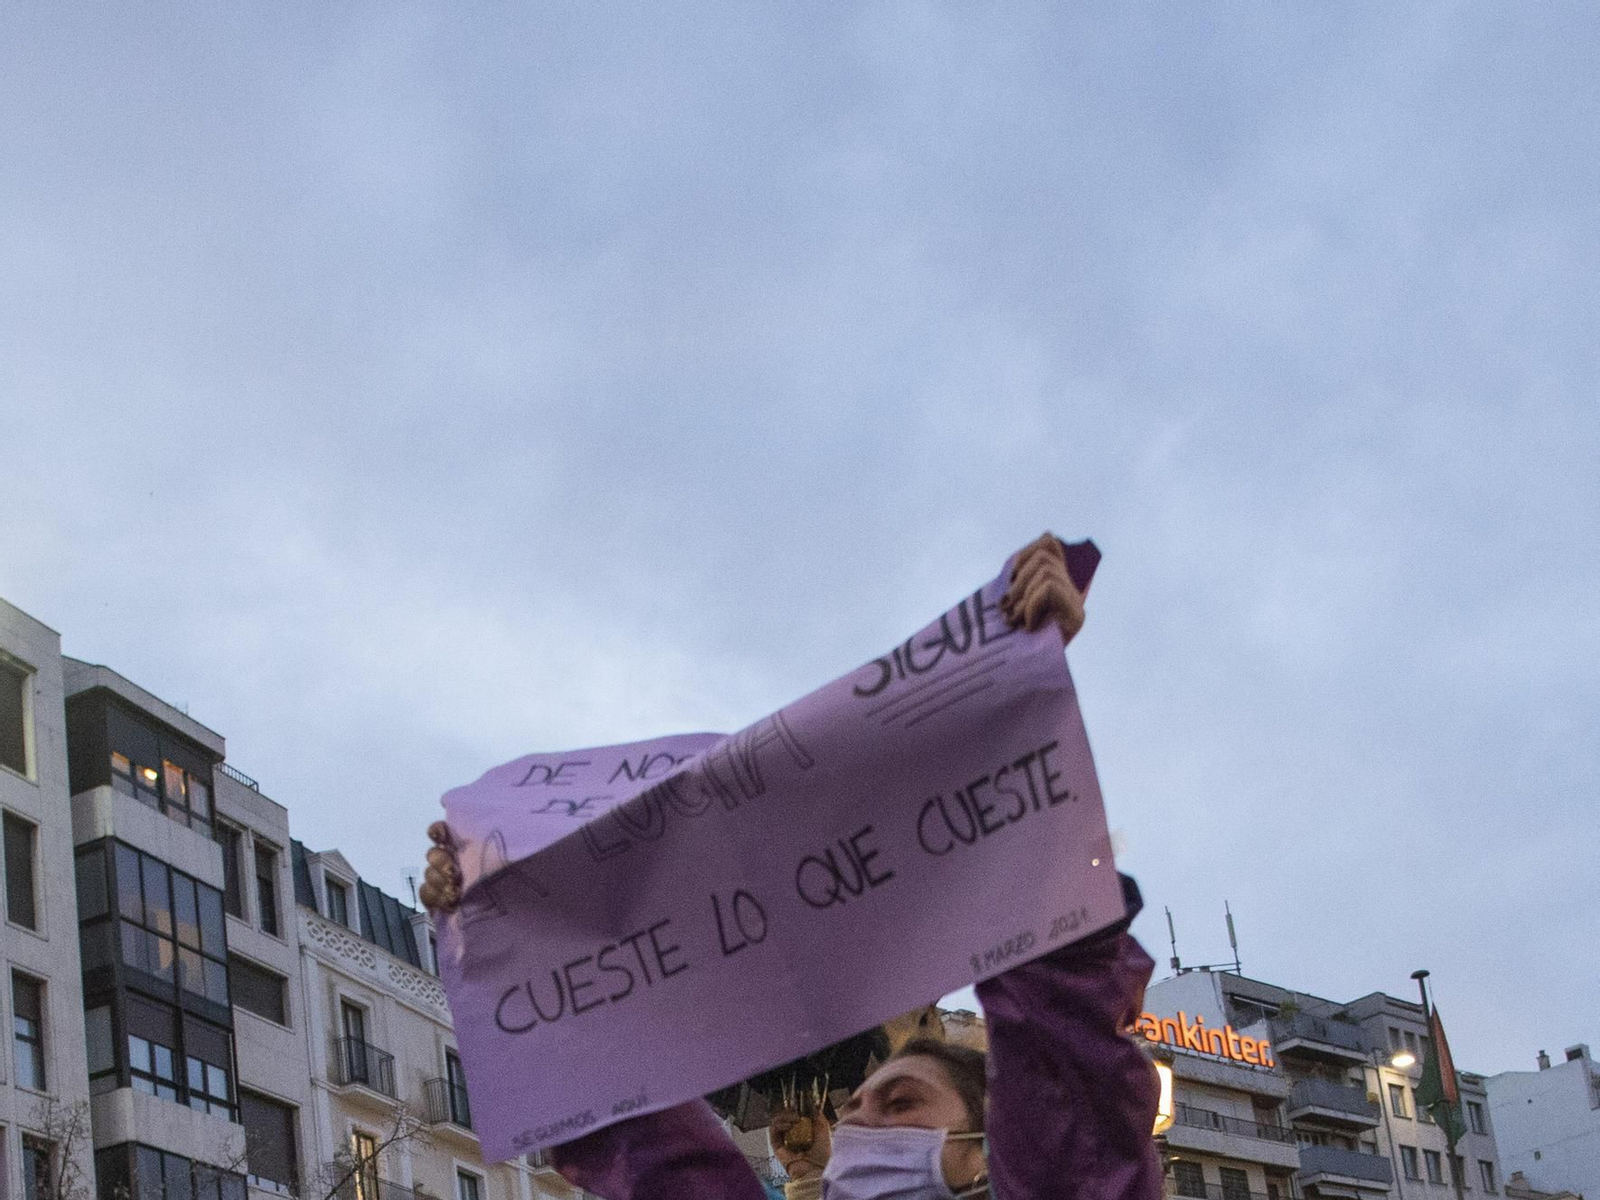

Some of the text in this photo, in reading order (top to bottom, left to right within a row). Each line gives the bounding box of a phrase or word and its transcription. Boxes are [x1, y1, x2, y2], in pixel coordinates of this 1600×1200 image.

[513, 760, 592, 788] DE
[493, 918, 690, 1036] CUESTE
[710, 888, 769, 957] LO
[795, 825, 896, 910] QUE
